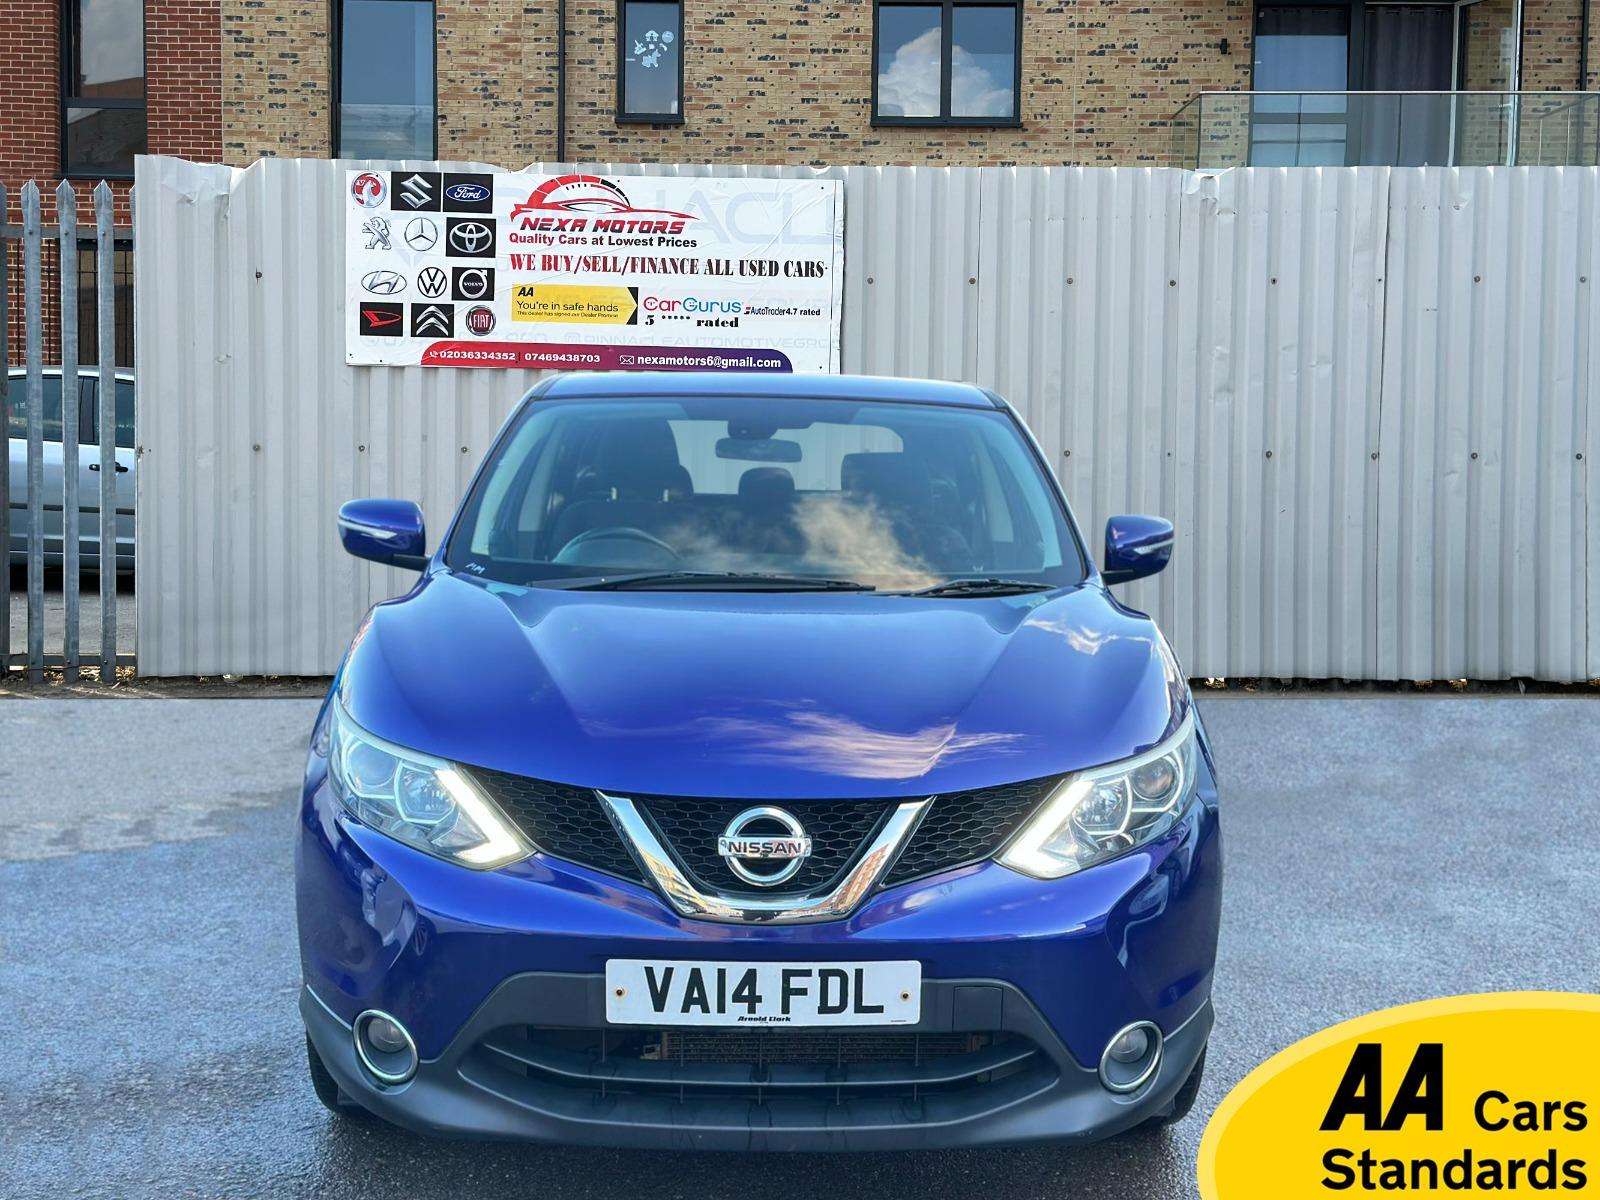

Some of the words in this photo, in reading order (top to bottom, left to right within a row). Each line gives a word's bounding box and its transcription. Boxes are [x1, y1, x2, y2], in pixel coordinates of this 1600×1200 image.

[453, 186, 481, 199] Ford
[520, 217, 585, 232] NEXA
[592, 219, 686, 235] MOTORS
[509, 232, 554, 246] Quality
[558, 234, 588, 245] Cars
[591, 235, 604, 246] at
[608, 235, 654, 247] Lowest
[657, 237, 697, 248] Prices
[509, 253, 536, 271] WE
[703, 258, 734, 276] ALL
[739, 260, 780, 277] USED
[784, 260, 825, 278] CARS
[517, 286, 534, 297] AA
[516, 300, 549, 310] You're
[551, 302, 561, 310] in
[563, 302, 585, 311] safe
[587, 303, 619, 312] hands
[643, 296, 742, 314] CarGurus
[800, 308, 821, 316] rated
[473, 314, 490, 328] FIAT
[645, 314, 655, 326] 5
[696, 316, 739, 328] rated
[440, 351, 516, 360] 02036334352
[524, 352, 601, 363] 07469438703
[637, 356, 782, 370] nexamotors6@gmail.com
[728, 841, 801, 854] NISSAN
[643, 966, 763, 1015] VA14
[781, 968, 885, 1015] FDL
